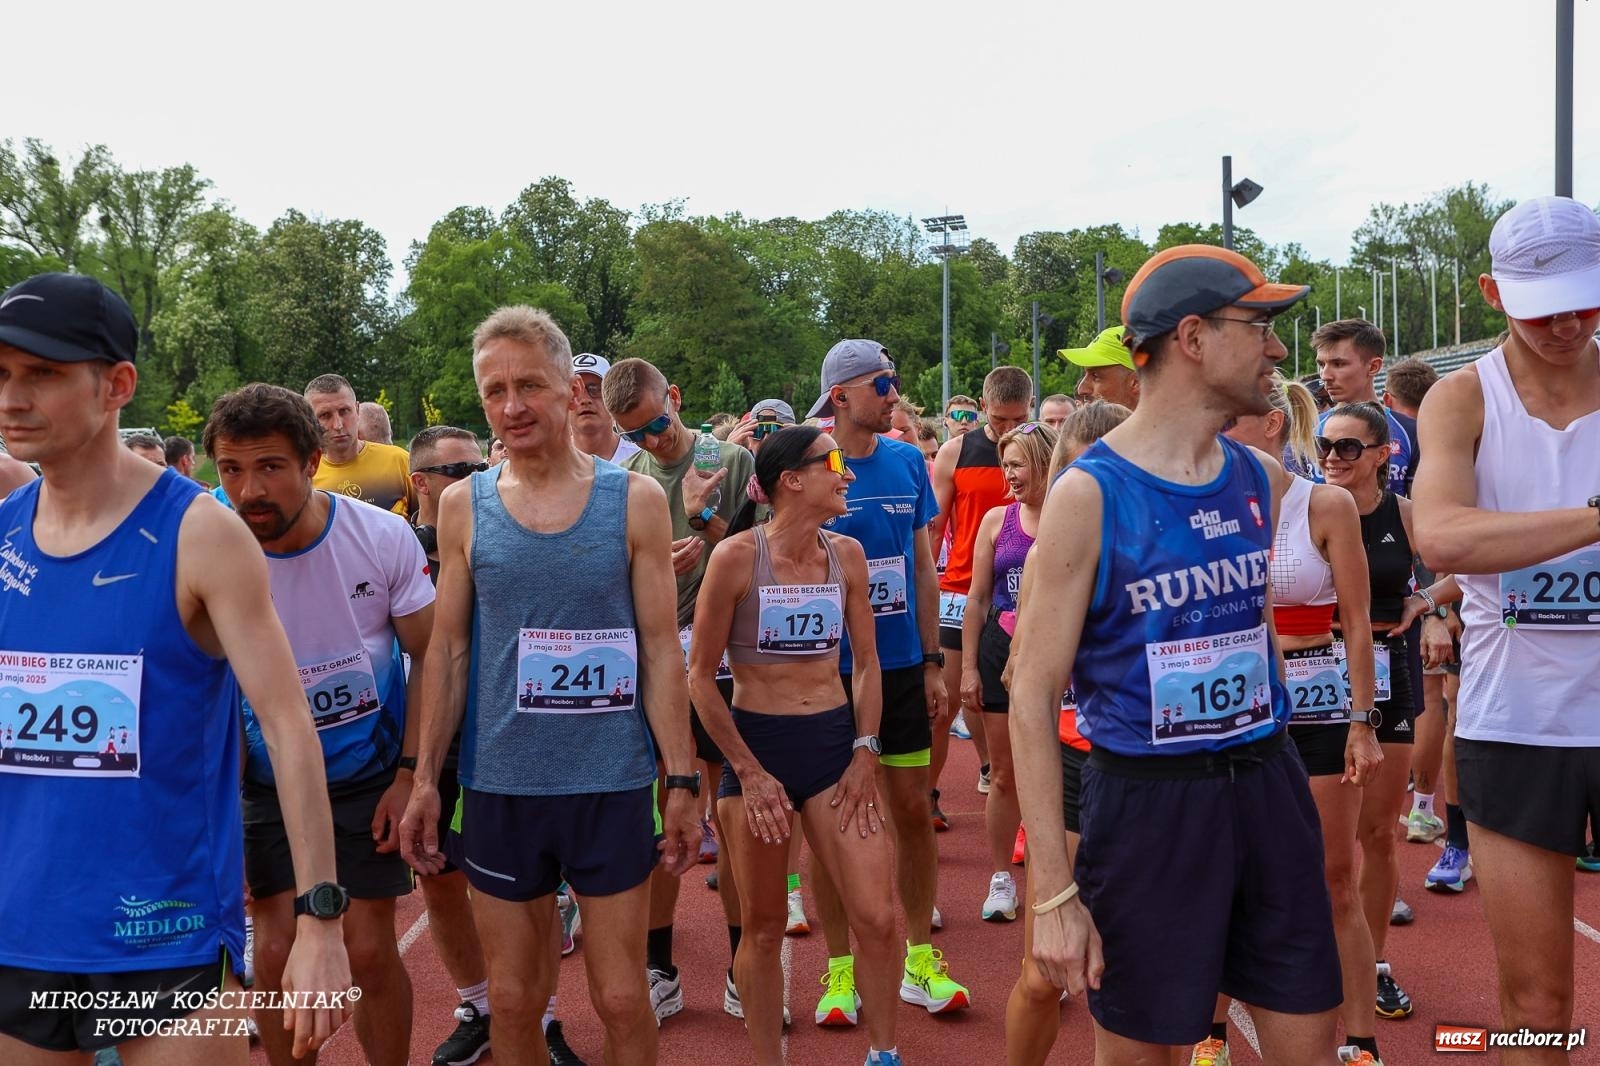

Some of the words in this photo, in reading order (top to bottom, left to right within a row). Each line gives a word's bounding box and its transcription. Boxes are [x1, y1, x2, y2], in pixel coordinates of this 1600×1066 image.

[801, 586, 814, 594] BEZ
[1532, 571, 1600, 604] 220
[785, 612, 824, 637] 173
[527, 630, 548, 640] XVII
[549, 631, 573, 640] BIEG
[574, 631, 593, 641] BEZ
[594, 631, 629, 640] GRANIC
[527, 643, 533, 651] 3
[554, 644, 572, 652] 2025
[1159, 644, 1182, 656] XVII
[1183, 640, 1211, 653] BIEG
[1211, 636, 1232, 649] BEZ
[0, 655, 19, 666] XVII
[21, 656, 47, 668] BIEG
[50, 658, 73, 669] BEZ
[76, 659, 129, 671] GRANIC
[311, 664, 328, 674] BEZ
[329, 653, 362, 670] GRANIC
[1160, 662, 1166, 670] 3
[1167, 660, 1191, 668] maja
[1191, 655, 1213, 666] 2025
[1289, 660, 1307, 668] BIEG
[5, 674, 25, 684] maja
[25, 674, 47, 684] 2025
[550, 663, 606, 692] 241
[1191, 673, 1247, 714] 163
[1294, 684, 1339, 709] 223
[17, 702, 99, 744] 249
[113, 914, 206, 937] MEDLOR
